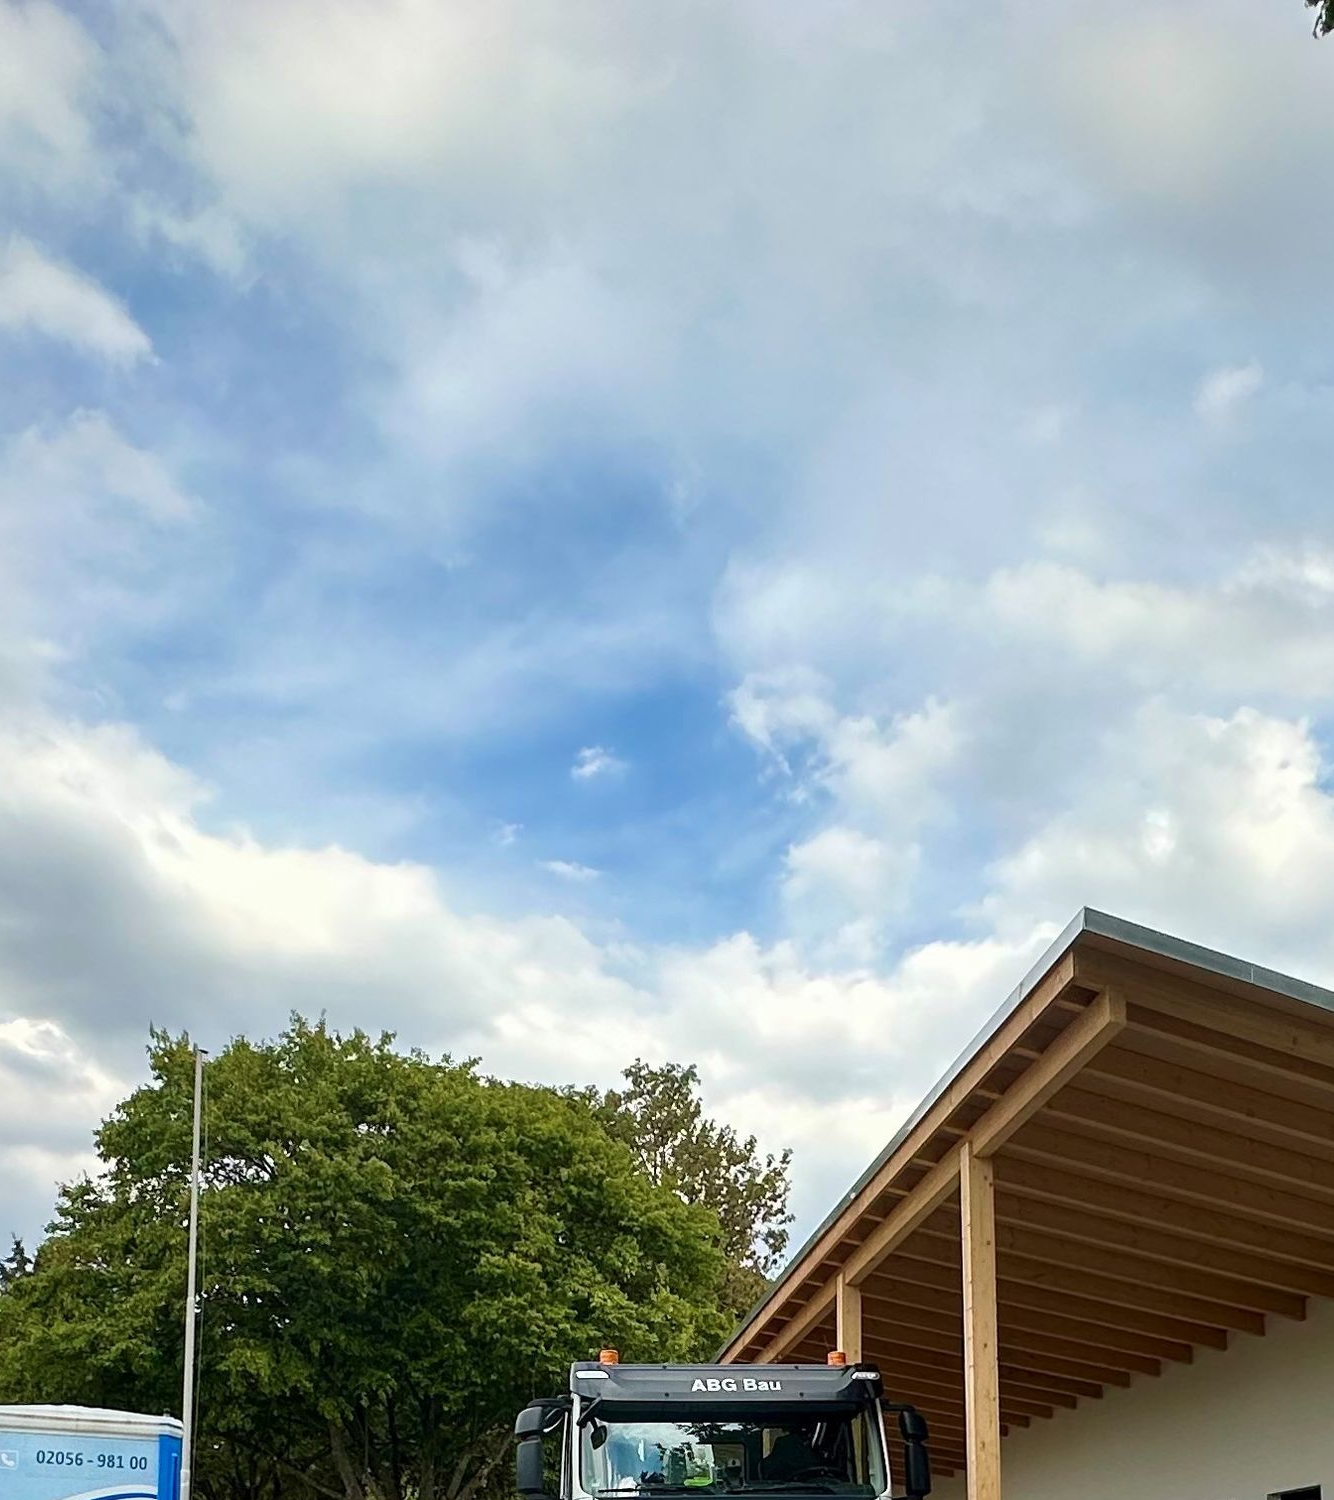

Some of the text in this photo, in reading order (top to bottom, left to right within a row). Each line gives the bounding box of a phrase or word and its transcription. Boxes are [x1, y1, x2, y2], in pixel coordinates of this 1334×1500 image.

[691, 1378, 782, 1393] ABG Bau
[36, 1450, 84, 1467] 02056
[97, 1454, 124, 1469] 981
[129, 1456, 148, 1471] 00
